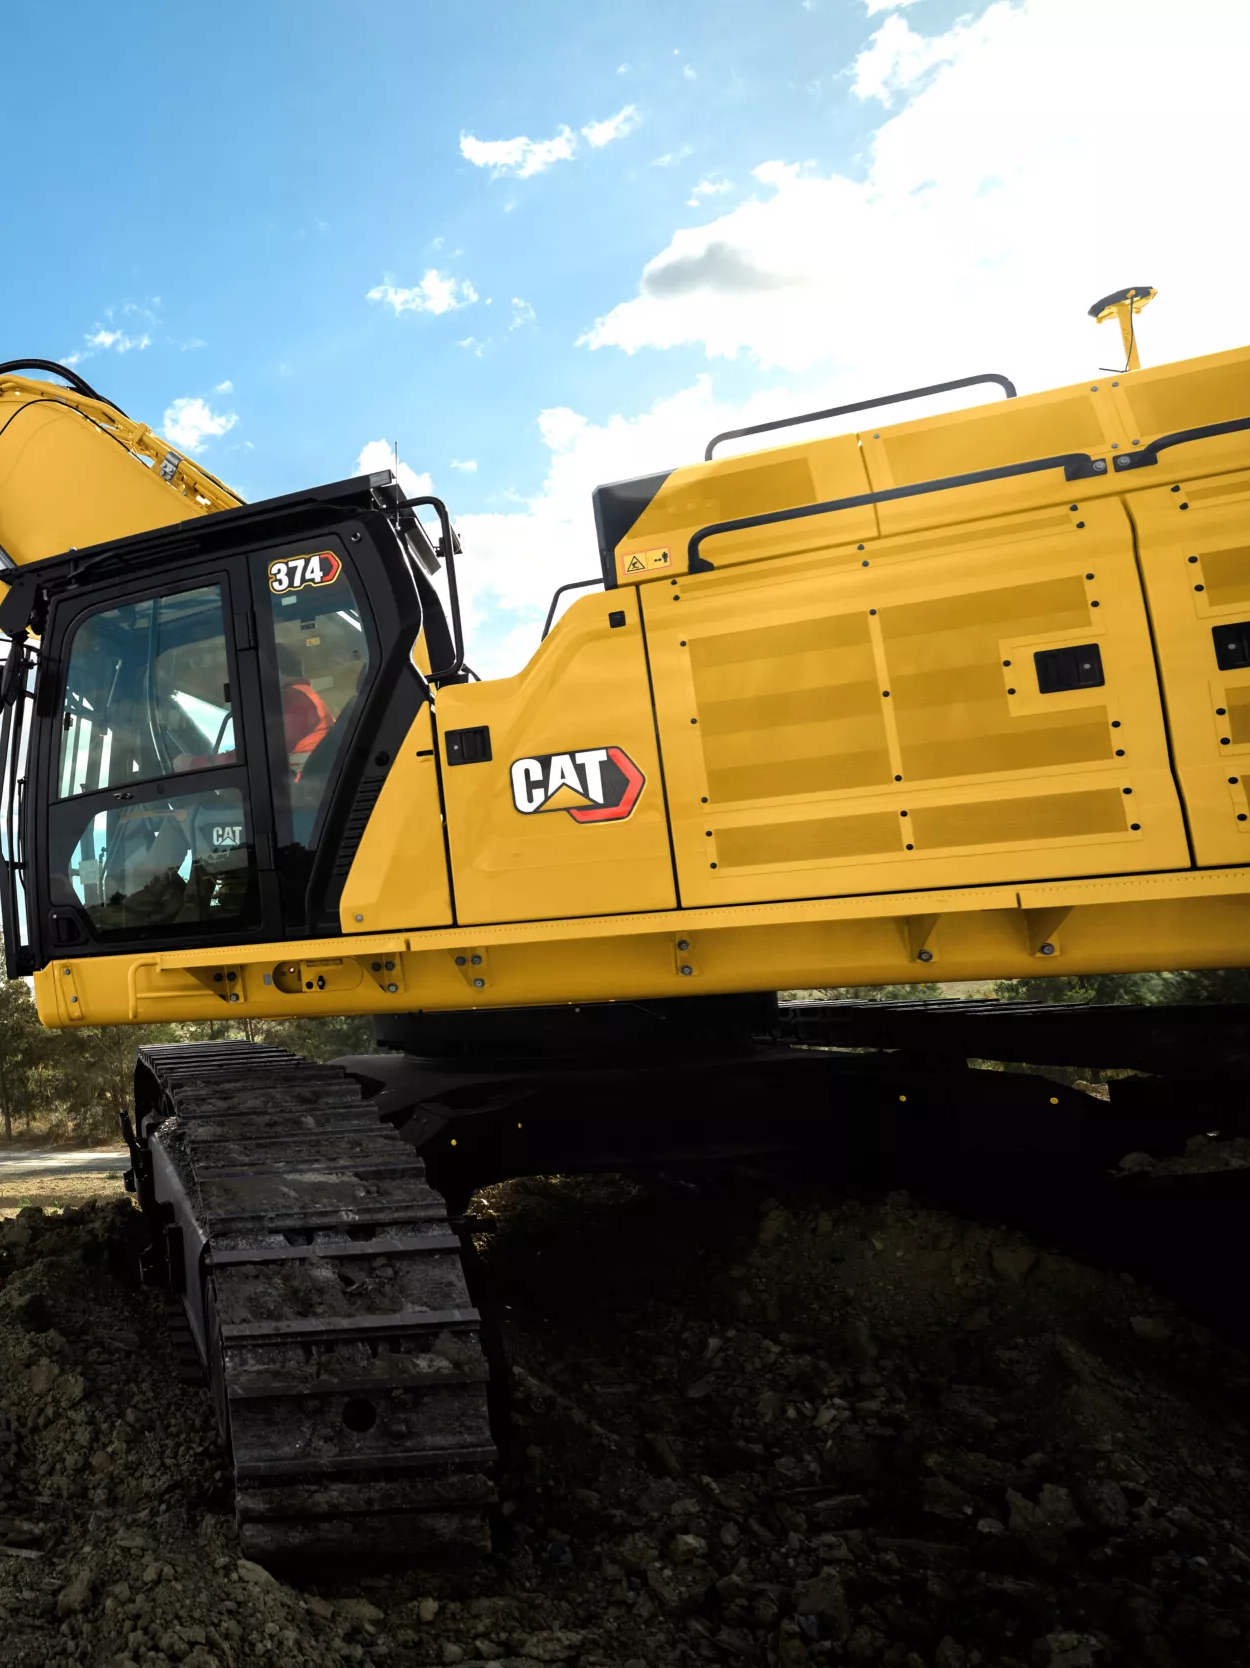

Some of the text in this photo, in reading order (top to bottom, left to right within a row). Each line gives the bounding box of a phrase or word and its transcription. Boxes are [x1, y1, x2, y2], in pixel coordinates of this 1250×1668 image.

[270, 555, 323, 591] 374
[511, 749, 607, 813] CAT
[212, 826, 242, 846] CAT
